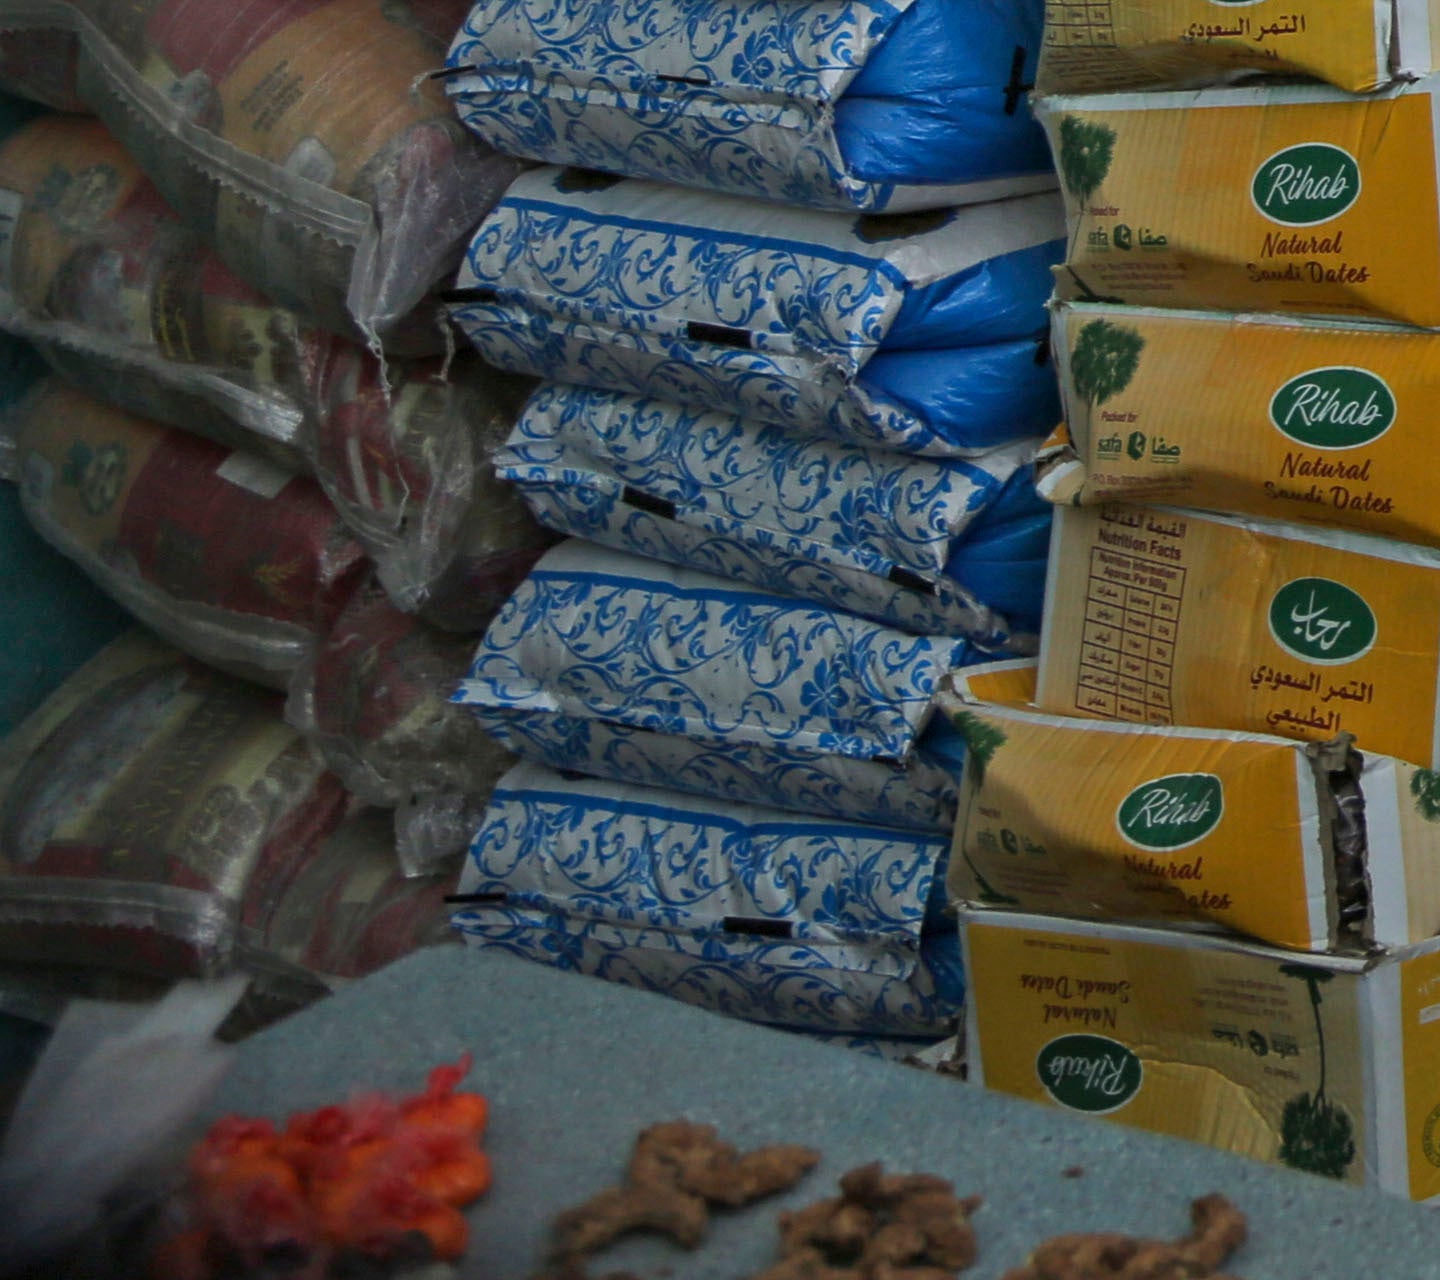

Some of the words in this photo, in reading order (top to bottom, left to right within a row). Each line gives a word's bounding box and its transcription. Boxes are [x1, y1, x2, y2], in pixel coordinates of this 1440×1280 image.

[1182, 18, 1254, 40] السعودي
[1259, 14, 1306, 43] التمر
[1264, 164, 1350, 206] Rihab
[1261, 230, 1343, 258] Natural
[1246, 263, 1302, 283] Saudi
[1307, 262, 1371, 284] Dates
[1284, 384, 1383, 427] Rihab
[1096, 432, 1122, 454] safa
[1279, 452, 1372, 481] Natural
[1263, 481, 1326, 506] Saudi
[1330, 486, 1395, 514] Dates
[1098, 528, 1147, 554] Nutrition
[1149, 540, 1182, 561] Facts
[1250, 664, 1321, 694] السعودي
[1320, 681, 1374, 705] التمر
[1267, 704, 1341, 733] الطبيعي
[1128, 787, 1211, 829] Rihab
[1123, 853, 1204, 881] Natural
[1048, 1050, 1129, 1097] Rihab
